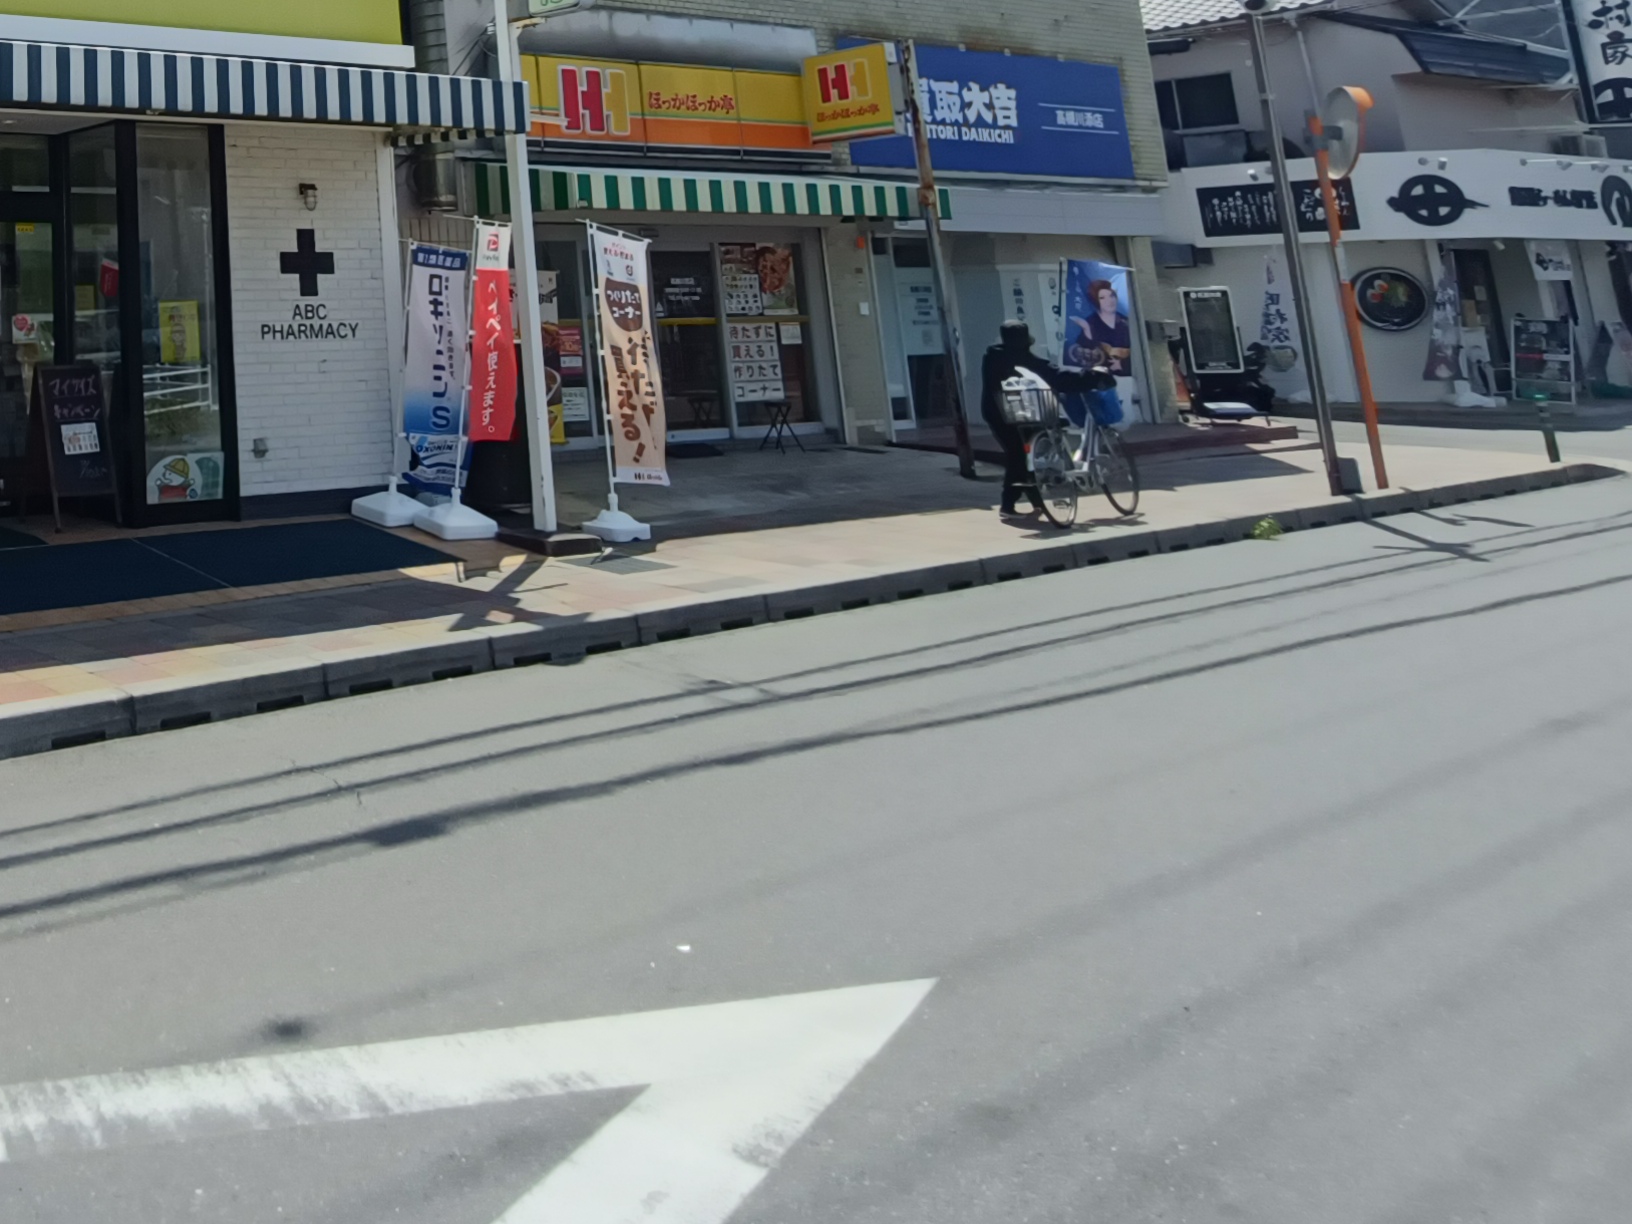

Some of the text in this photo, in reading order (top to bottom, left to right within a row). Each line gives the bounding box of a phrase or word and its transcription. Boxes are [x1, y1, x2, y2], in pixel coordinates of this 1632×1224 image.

[647, 90, 735, 115] ほっかほっか亭
[816, 103, 880, 123] ほっかほっか亭
[961, 127, 1015, 144] DAIKICHI
[291, 303, 328, 321] ABC
[611, 305, 642, 319] コーナー
[260, 322, 359, 341] PHARMACY
[729, 325, 776, 339] 待たずに
[481, 278, 502, 433] ペイペイ使えます。
[731, 345, 775, 358] 買える!
[733, 364, 780, 378] 作りたて
[736, 385, 782, 398] コーナー
